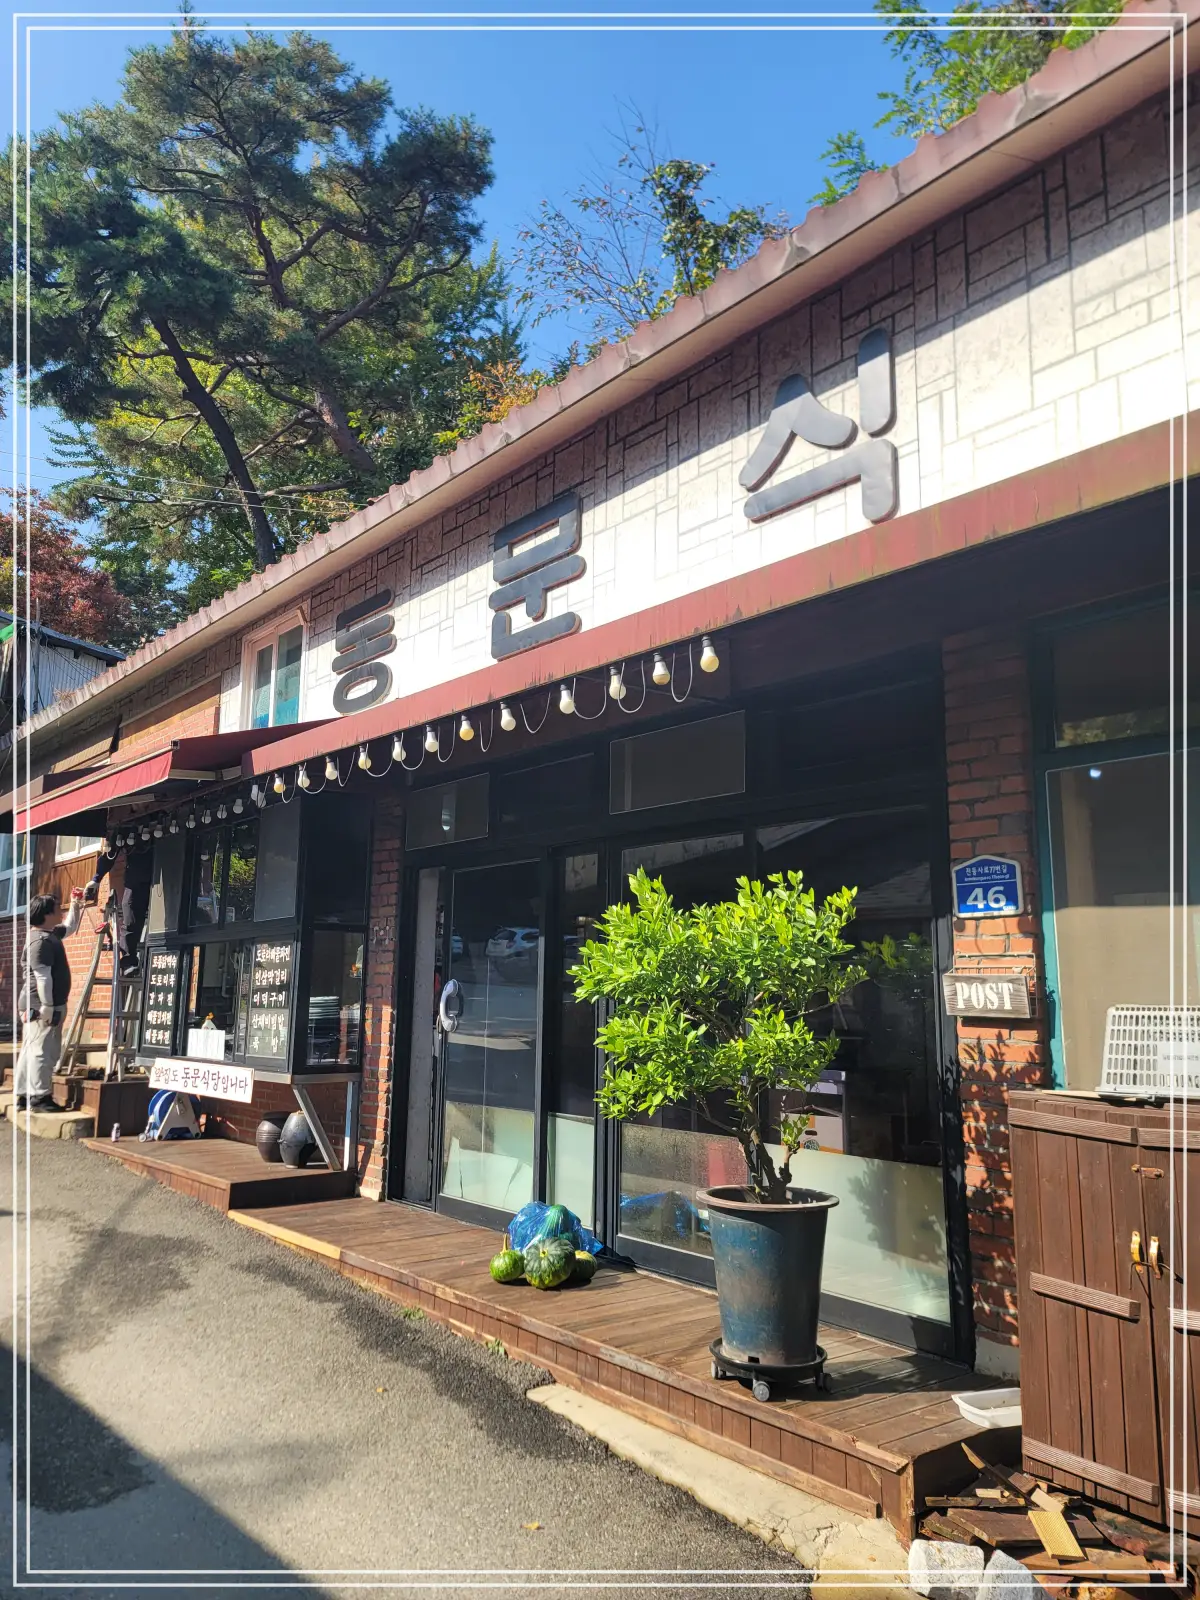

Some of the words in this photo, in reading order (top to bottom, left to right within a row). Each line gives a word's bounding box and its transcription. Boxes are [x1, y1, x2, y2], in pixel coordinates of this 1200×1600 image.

[966, 886, 1007, 909] 46
[150, 974, 176, 987] 도토리묵
[255, 969, 287, 986] 인삼막걸리
[253, 991, 286, 1008] 더덕구이
[955, 982, 1014, 1010] POST
[251, 1014, 285, 1030] 산채비빔밥
[145, 1029, 171, 1045] 해물파전
[181, 1067, 249, 1095] 동문식당입니다
